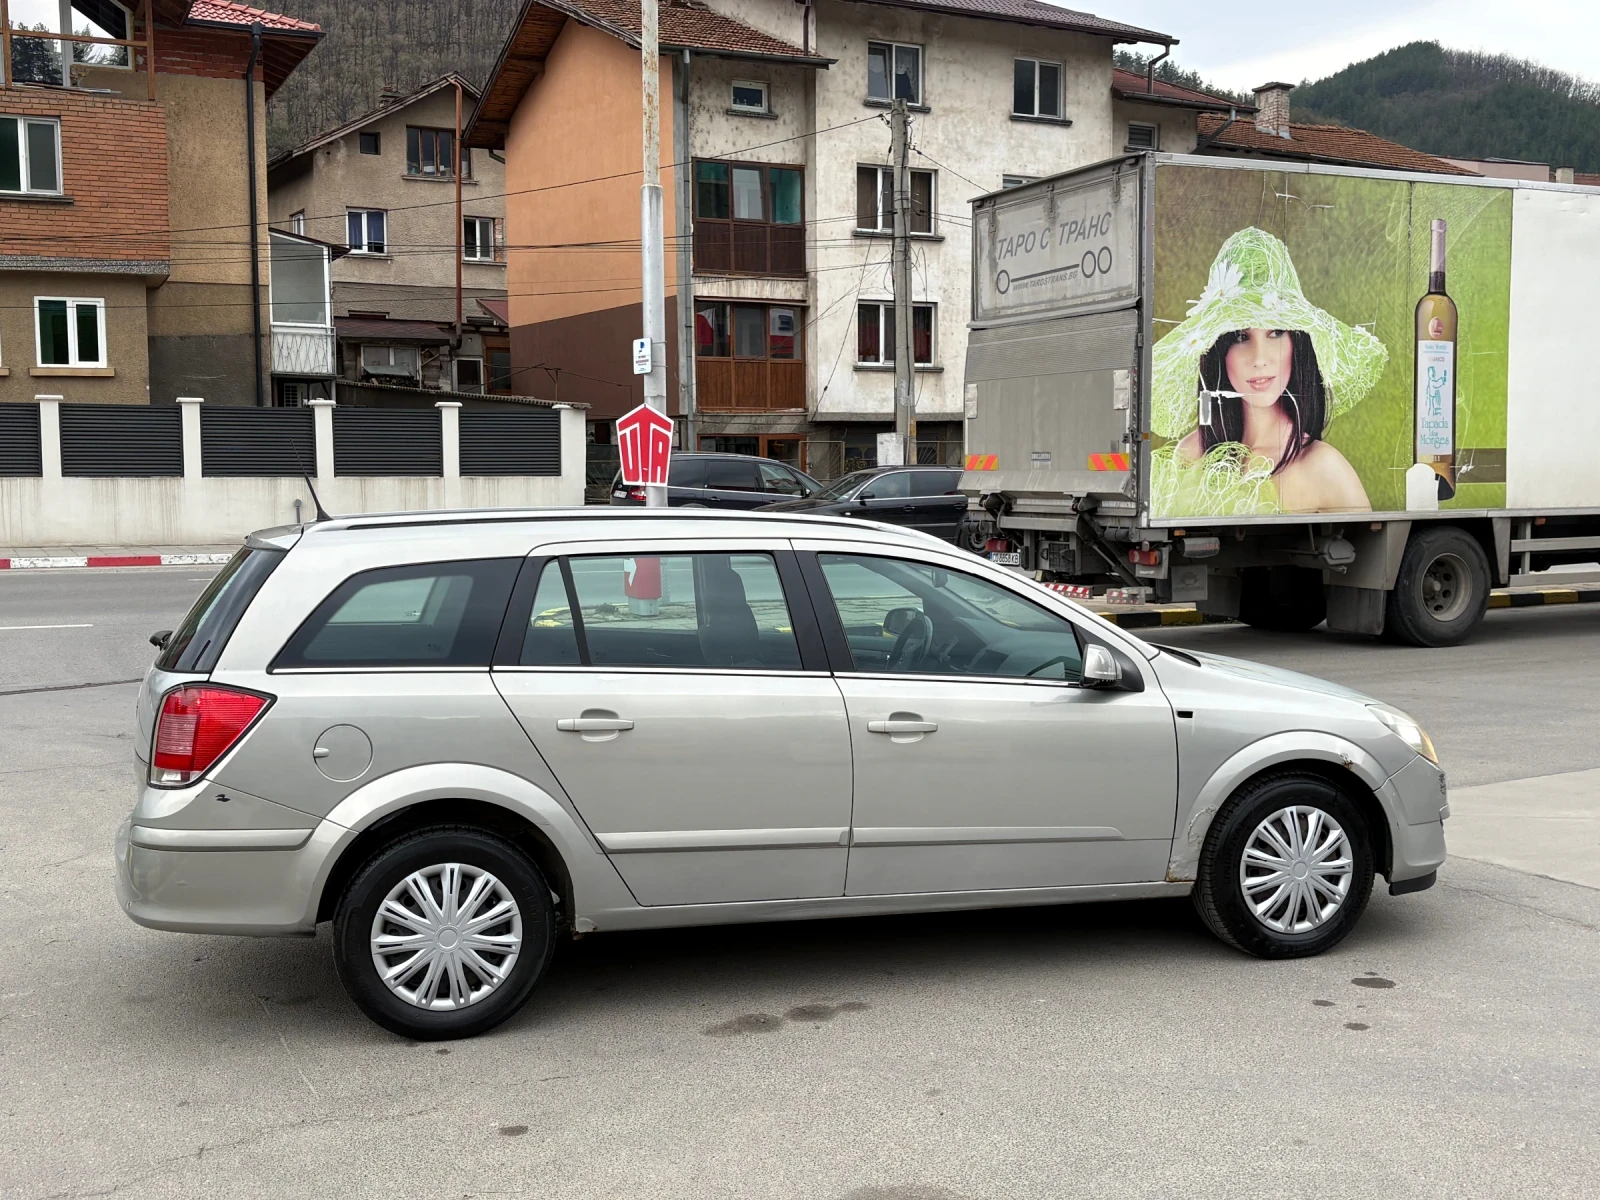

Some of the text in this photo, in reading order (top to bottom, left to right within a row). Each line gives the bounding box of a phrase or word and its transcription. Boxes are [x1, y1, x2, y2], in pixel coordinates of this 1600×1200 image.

[998, 231, 1036, 260] ТАРО
[1059, 211, 1112, 246] ТРАНС
[1421, 417, 1449, 431] Tapada
